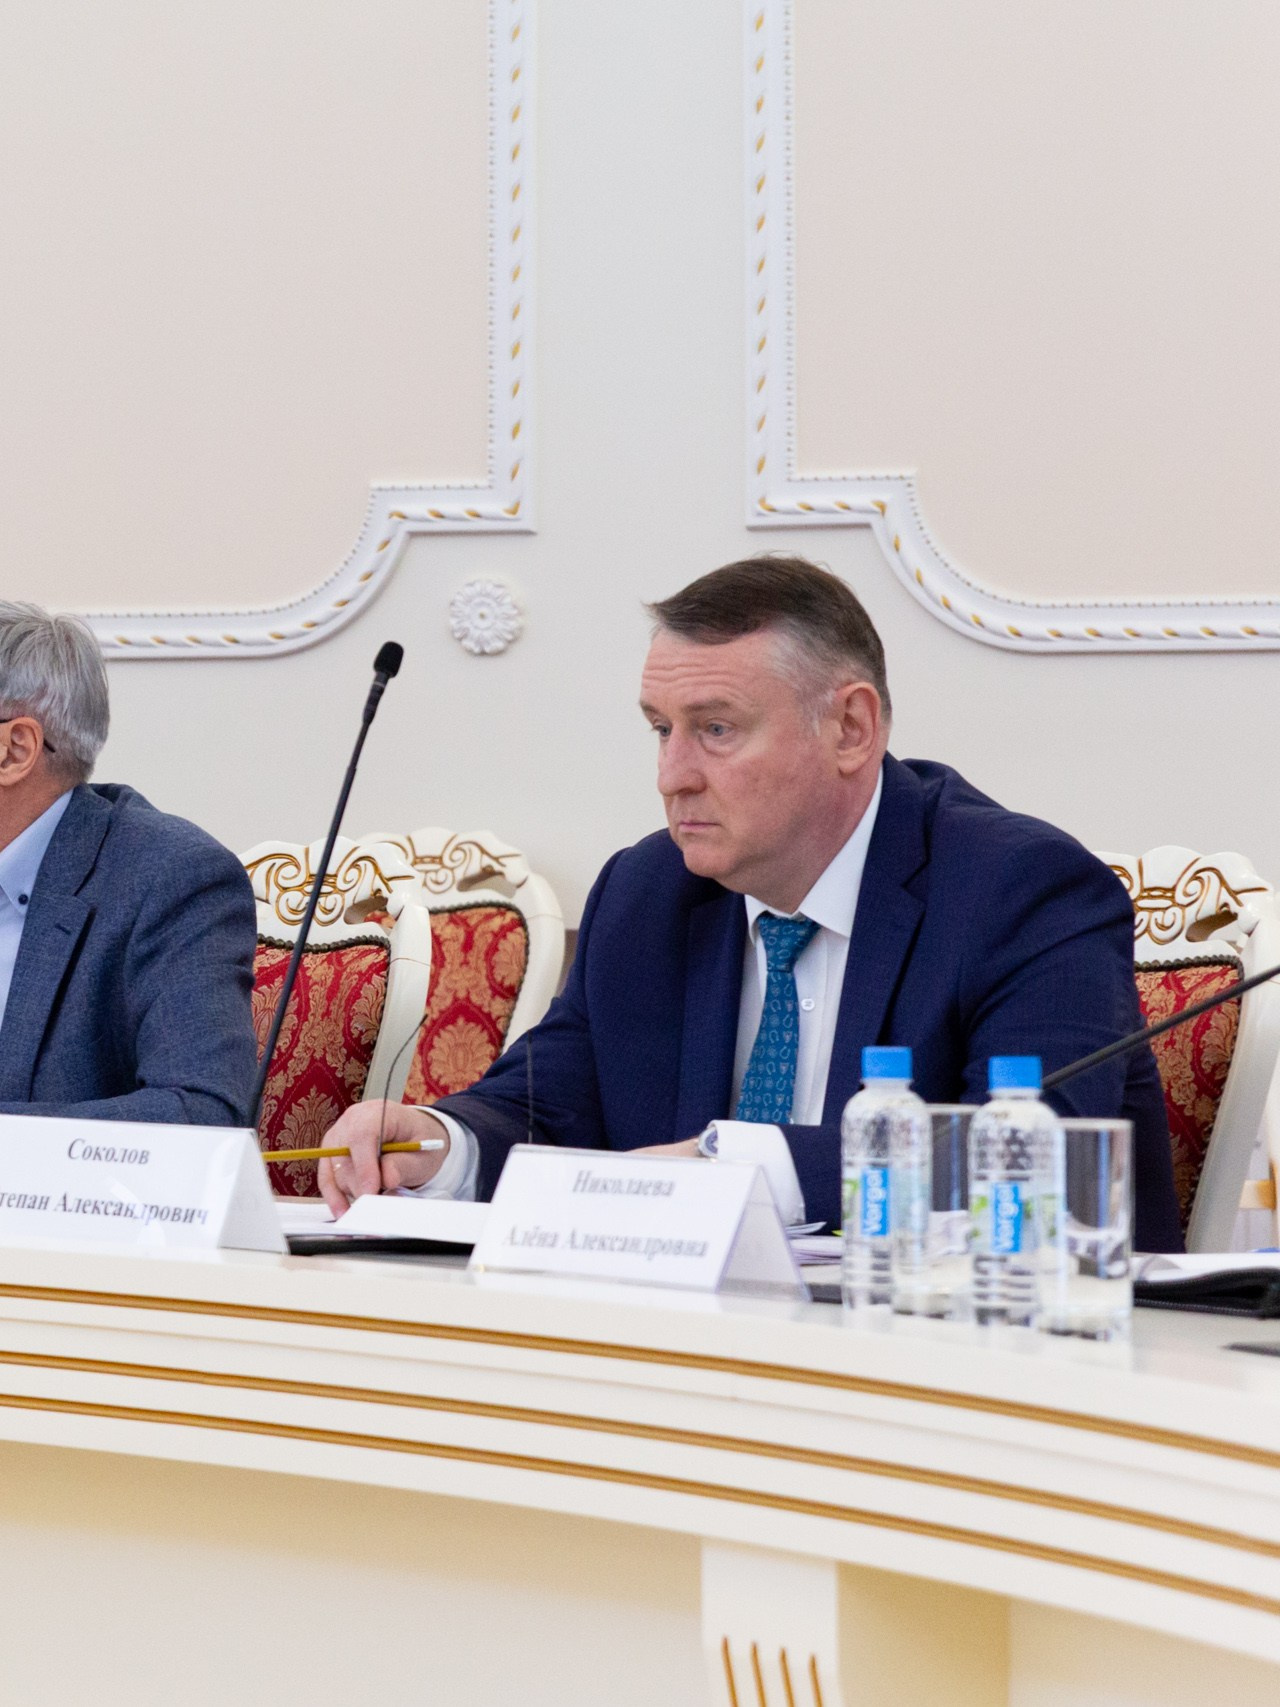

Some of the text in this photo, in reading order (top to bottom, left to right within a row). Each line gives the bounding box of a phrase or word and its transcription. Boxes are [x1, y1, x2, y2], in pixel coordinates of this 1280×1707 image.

[67, 1138, 150, 1165] Соколов
[572, 1170, 675, 1196] Николаева
[54, 1192, 209, 1225] Александрович
[503, 1225, 709, 1260] Алёна Александровна
